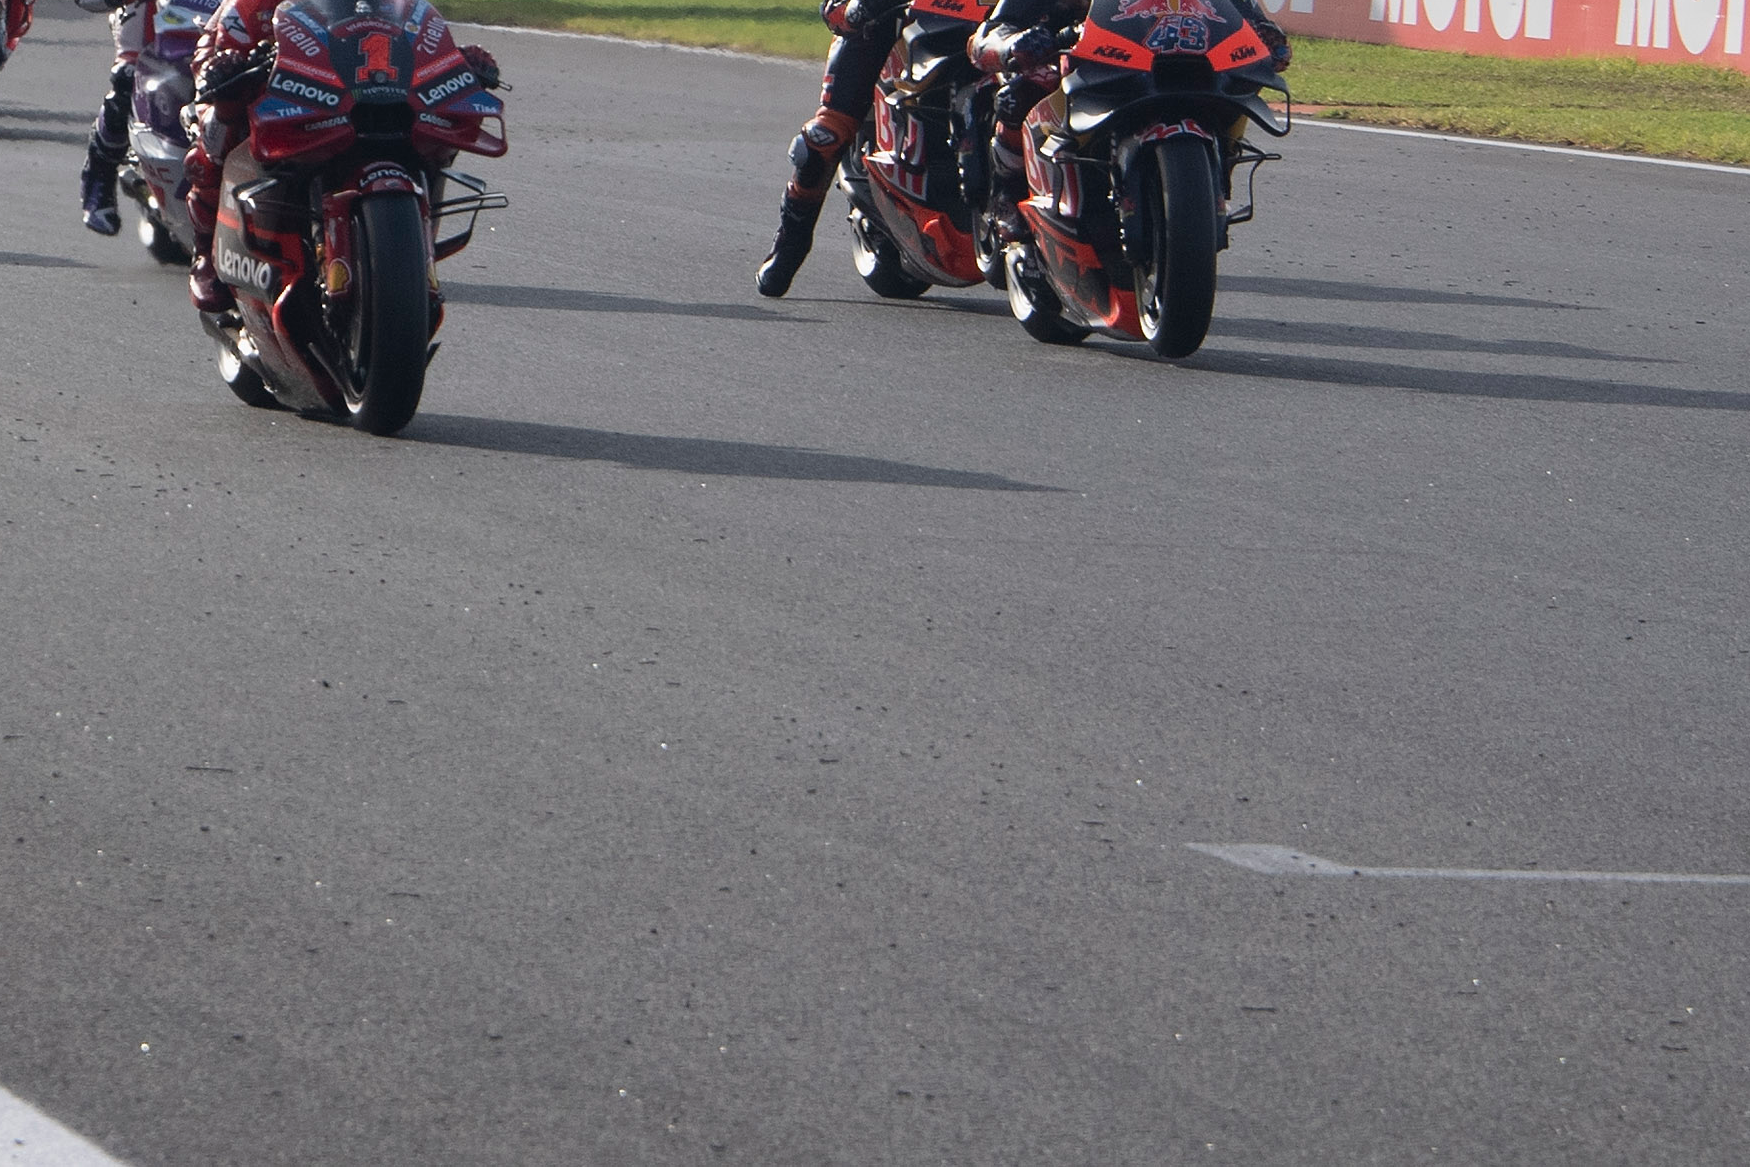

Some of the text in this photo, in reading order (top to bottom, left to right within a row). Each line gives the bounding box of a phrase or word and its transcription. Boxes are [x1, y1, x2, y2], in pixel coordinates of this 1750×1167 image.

[1144, 15, 1210, 55] 43
[355, 32, 399, 84] 1
[1092, 45, 1132, 62] KTM
[1229, 45, 1257, 62] KTM
[271, 73, 339, 106] Lenovo
[418, 71, 475, 106] Lenovo
[276, 106, 303, 117] TIM
[218, 238, 272, 289] Lenovo
